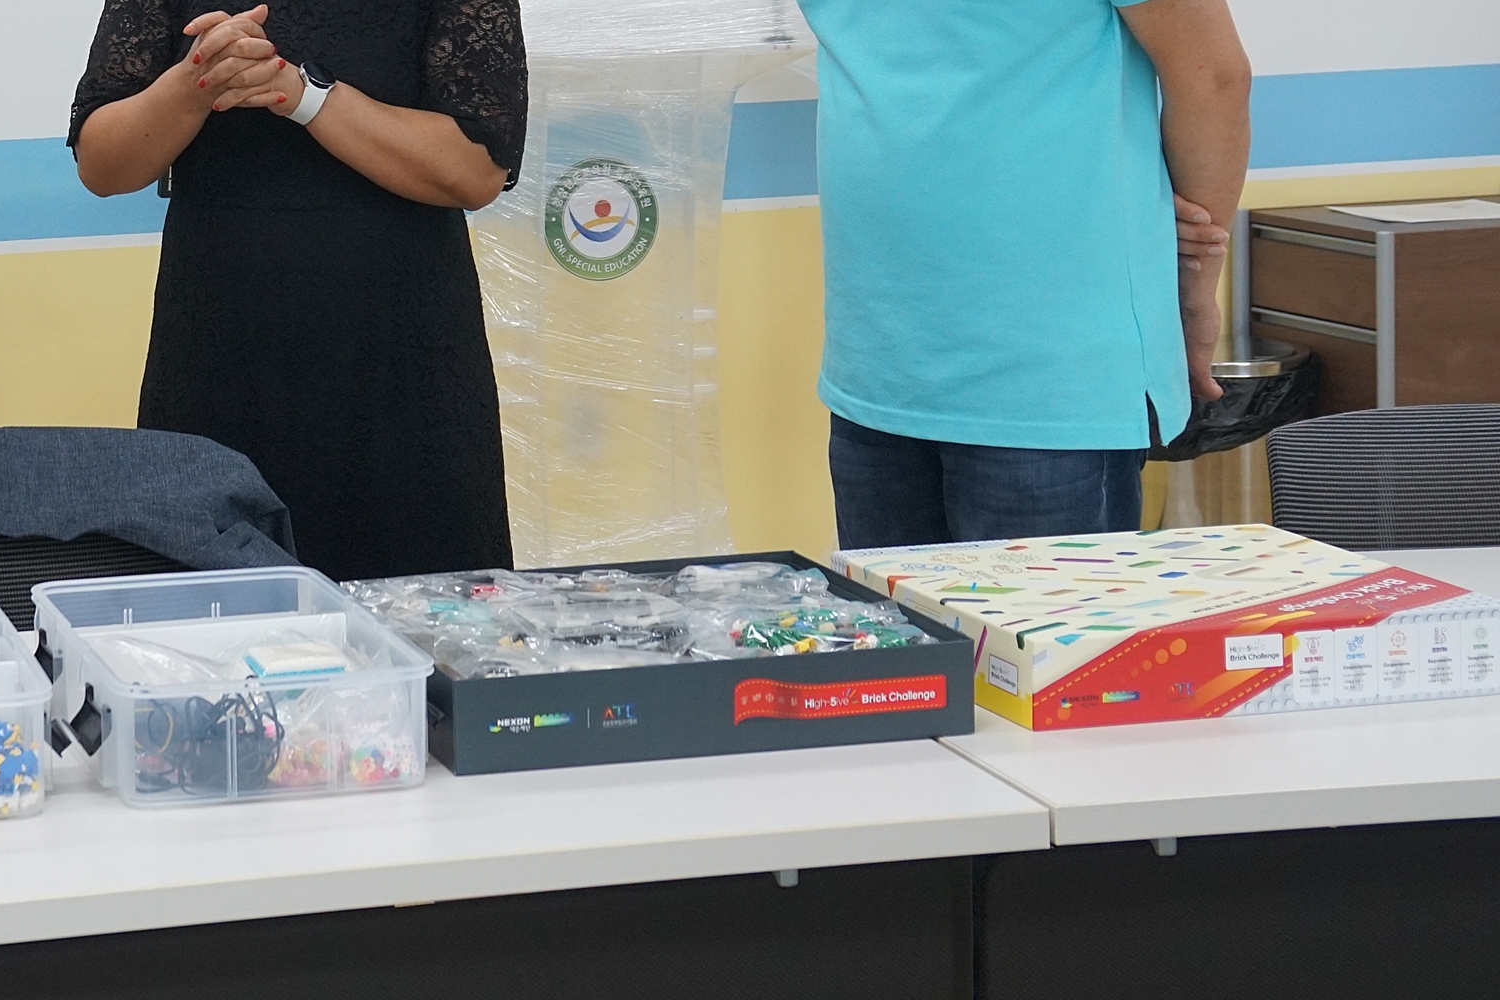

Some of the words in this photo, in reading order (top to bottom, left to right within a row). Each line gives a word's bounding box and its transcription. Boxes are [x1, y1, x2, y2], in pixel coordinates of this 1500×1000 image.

[566, 254, 602, 273] SPECIAL
[604, 237, 648, 273] EDUCATION
[1229, 654, 1246, 662] Brick
[1247, 651, 1281, 661] Challenge
[861, 693, 887, 704] Brick
[888, 689, 936, 702] Challenge
[1069, 695, 1099, 703] NEXON
[497, 716, 531, 726] NEXON
